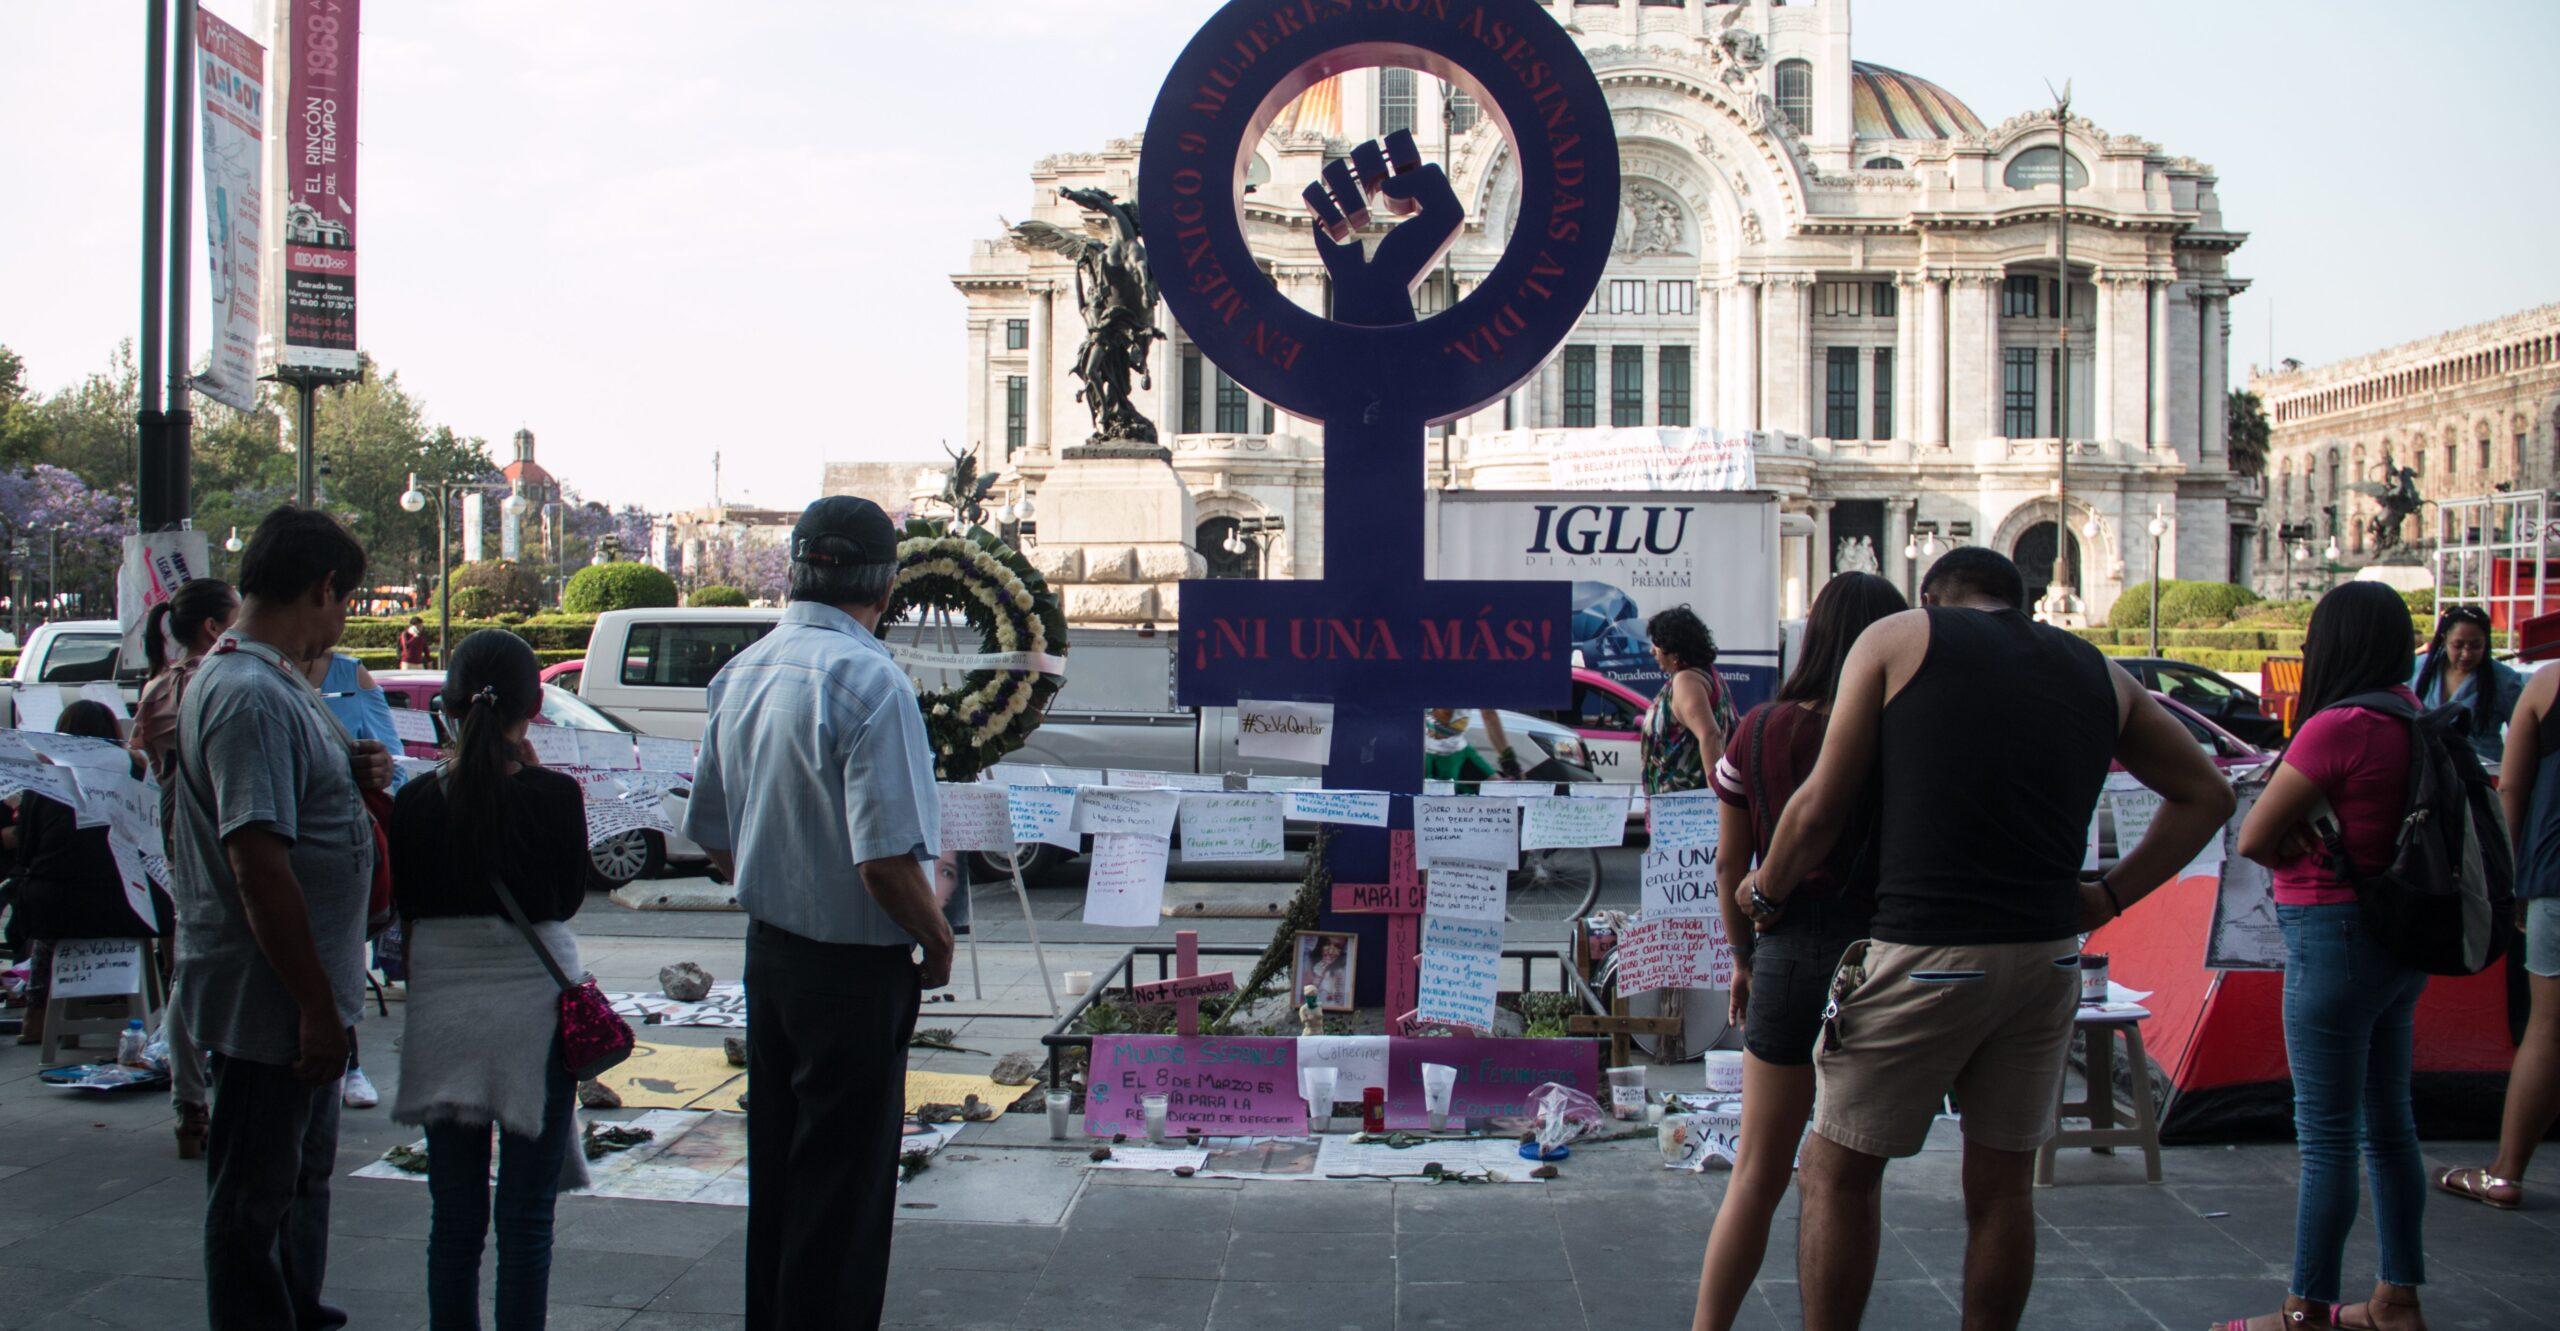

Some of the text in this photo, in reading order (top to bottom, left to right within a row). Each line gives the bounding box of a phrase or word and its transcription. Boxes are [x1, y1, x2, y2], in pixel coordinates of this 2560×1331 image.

[307, 14, 338, 77] 1968
[1457, 4, 1586, 243] ASESINADAS
[302, 97, 322, 194] EL RINCÓN
[322, 99, 337, 195] DEL TIEMPO
[1180, 132, 1208, 156] 9
[1171, 170, 1250, 327] MÉXICO
[1517, 250, 1566, 300] AL
[1246, 316, 1304, 371] EN
[1526, 505, 1694, 555] IGLU
[1526, 556, 1693, 567] DIAMANTE
[1632, 575, 1691, 588] PREMIUM
[1196, 604, 1552, 671] ¡NI UNA MÁS!
[1607, 670, 1661, 681] Duraderos
[1590, 750, 1618, 766] AXI
[1646, 868, 1704, 887] encubre
[1353, 887, 1400, 908] MARI
[1662, 880, 1719, 904] VIOLA
[1661, 931, 1679, 940] FES
[1122, 1068, 1273, 1094] EL 8 DE MARZO ES
[1189, 1094, 1251, 1110] PARA LA
[1219, 1114, 1234, 1123] DE
